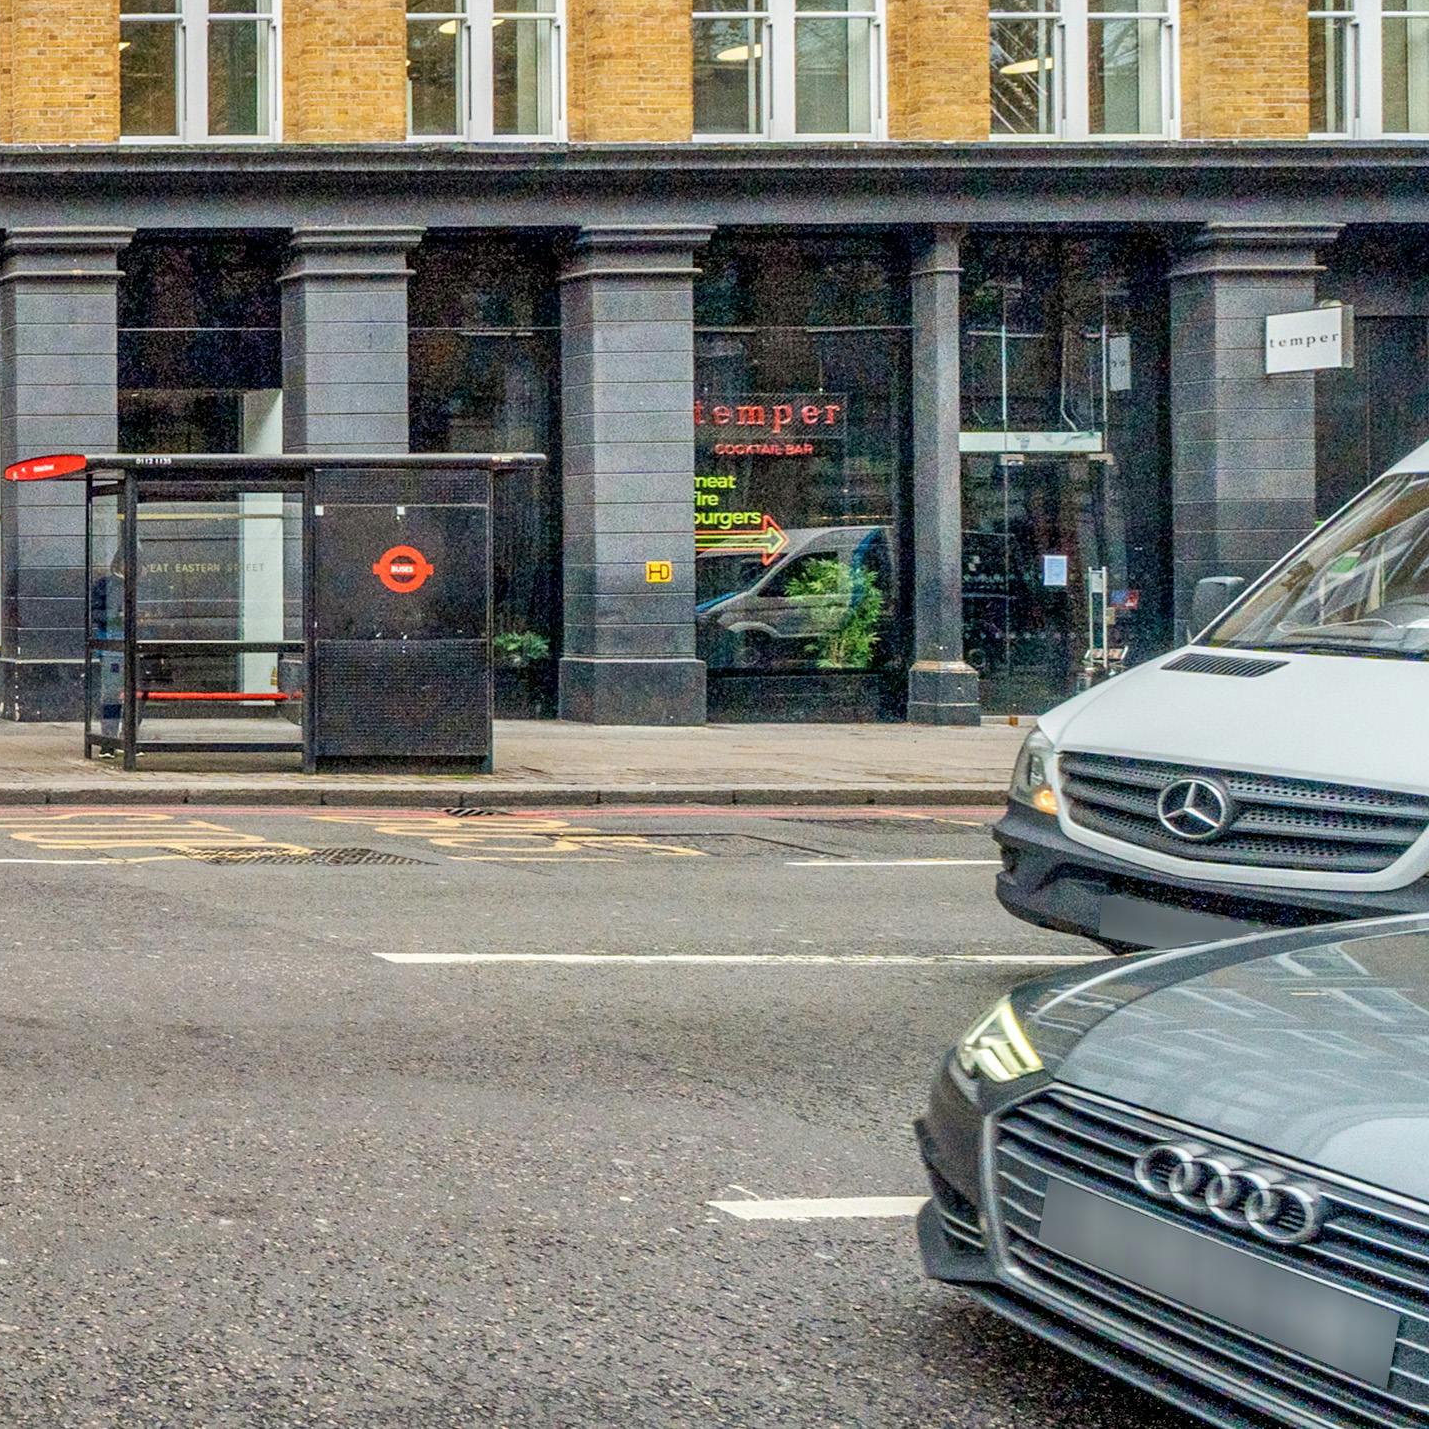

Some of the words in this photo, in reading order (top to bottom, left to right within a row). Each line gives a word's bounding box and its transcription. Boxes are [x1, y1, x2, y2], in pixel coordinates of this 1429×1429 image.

[1270, 333, 1339, 348] temper
[694, 400, 840, 433] temper
[715, 444, 782, 455] COCKTAIL
[786, 443, 813, 455] BAR
[176, 563, 220, 572] EASTERN
